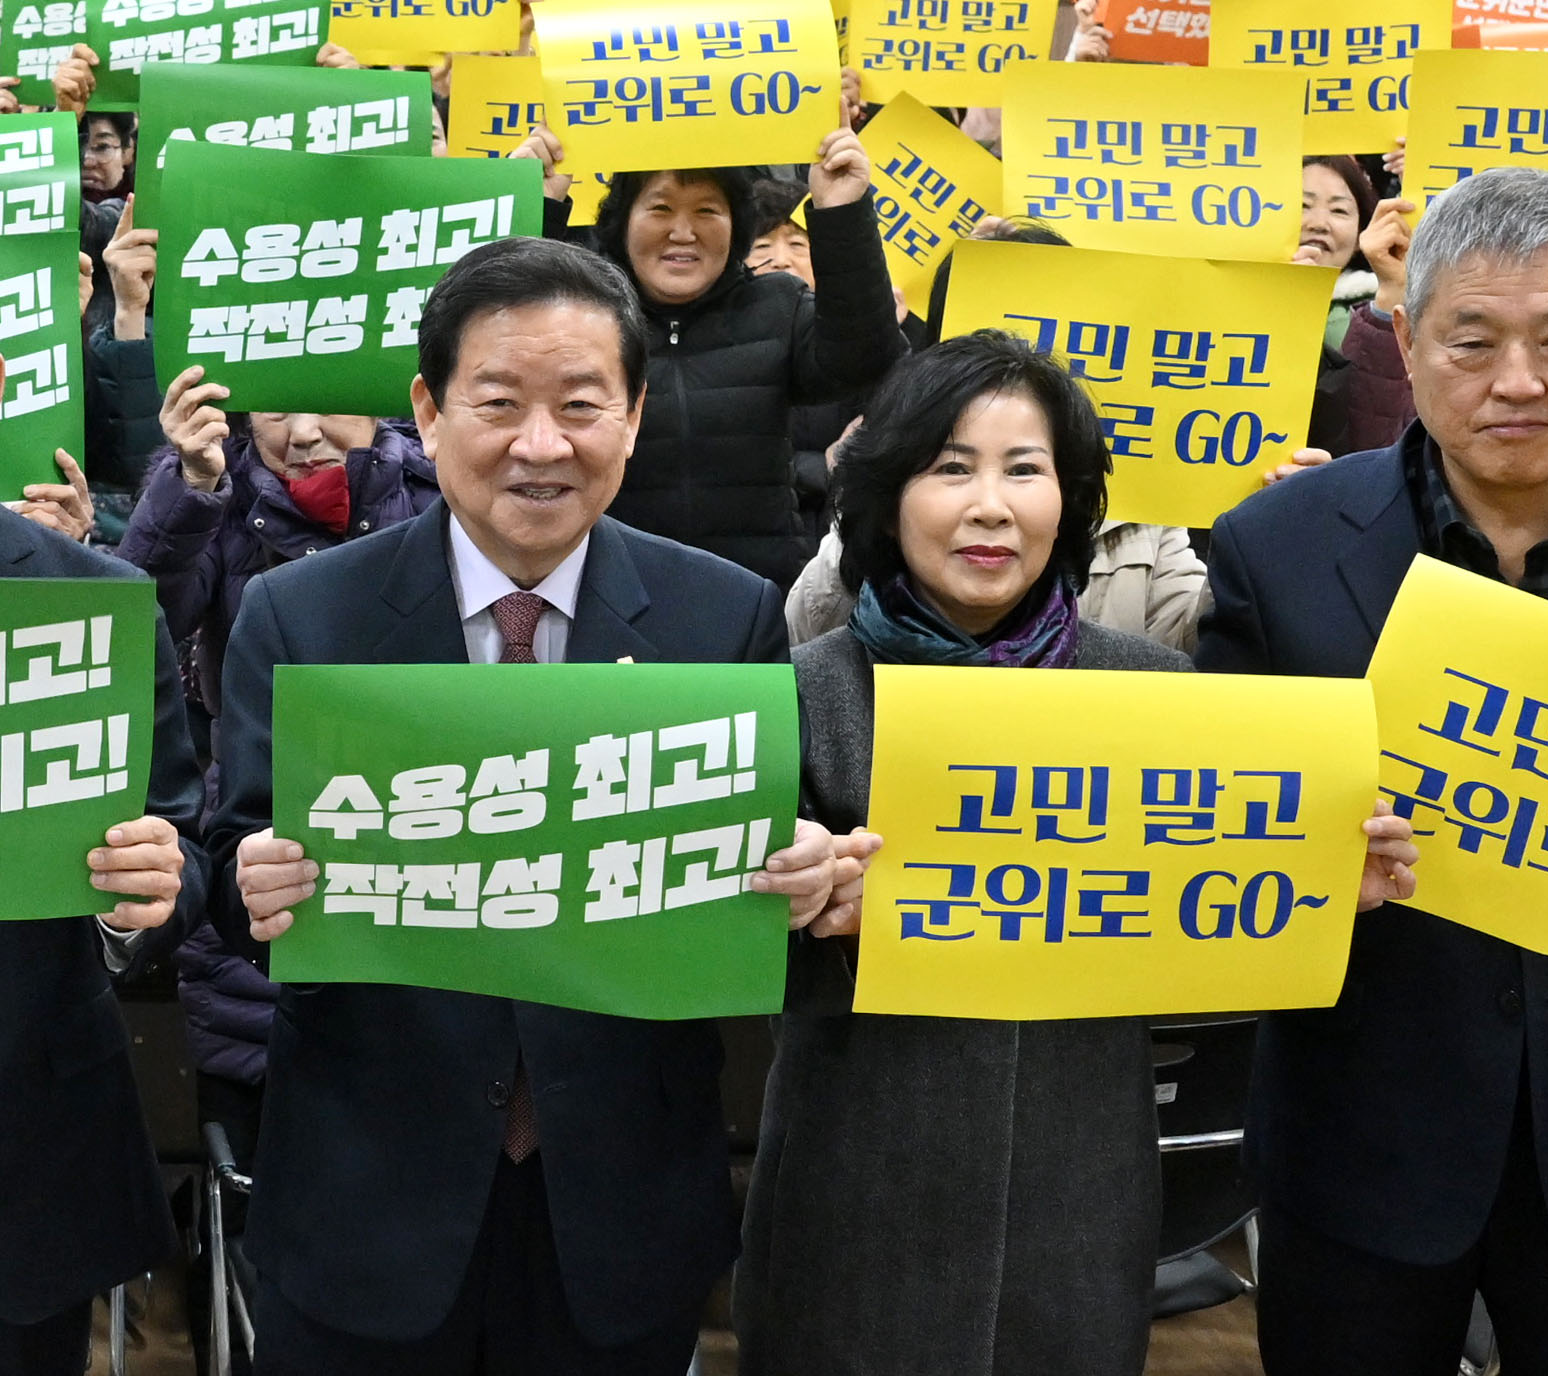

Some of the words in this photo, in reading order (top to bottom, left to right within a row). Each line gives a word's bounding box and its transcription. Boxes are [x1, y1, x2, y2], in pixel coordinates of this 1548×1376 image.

[231, 6, 320, 60] 최고!
[695, 19, 799, 61] 말고
[961, 0, 1031, 34] 말고
[861, 37, 968, 73] 군위로
[1243, 28, 1331, 67] 고민
[562, 74, 717, 127] 군위로
[1042, 117, 1144, 167] 고민
[1161, 123, 1264, 171] 말고
[1024, 174, 1175, 226] 군위로
[1190, 184, 1285, 230] GO~
[180, 216, 363, 288] 수용성
[185, 296, 367, 364] 작전성
[1150, 329, 1273, 392] 말고
[1174, 412, 1289, 469] GO~
[306, 746, 553, 843] 수용성
[569, 710, 760, 824] 최고!
[933, 761, 1111, 846] 고민
[1140, 765, 1308, 848] 말고
[320, 852, 564, 932] 작전성
[583, 816, 774, 925] 최고!
[894, 859, 1154, 946] 군위로
[1176, 867, 1332, 944] GO~
